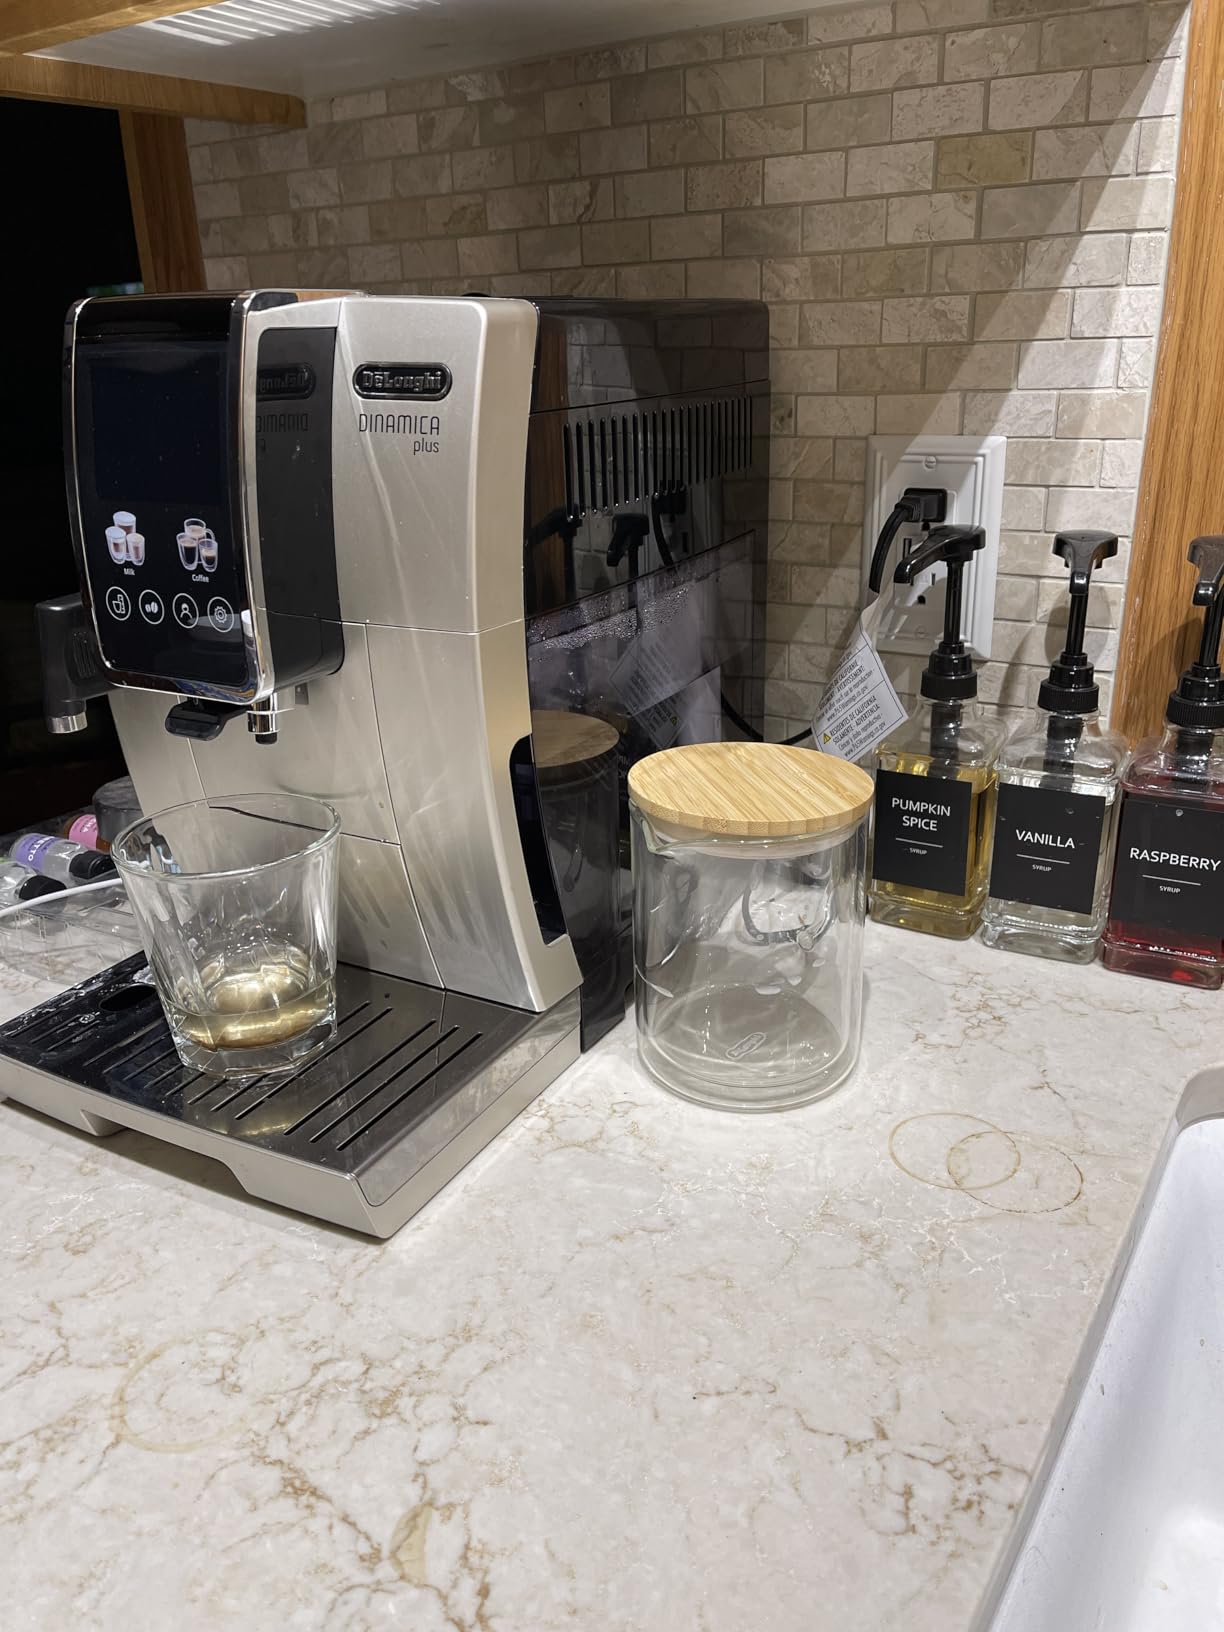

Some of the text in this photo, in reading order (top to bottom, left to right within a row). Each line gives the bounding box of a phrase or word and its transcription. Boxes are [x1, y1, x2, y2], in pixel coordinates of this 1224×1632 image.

[359, 413, 441, 436] DINAMICA
[413, 438, 440, 455] plus
[123, 567, 136, 576] Milk
[191, 574, 210, 583] Coffee
[891, 797, 951, 817] PUMPKIN
[902, 815, 938, 832] SPICE
[1015, 829, 1076, 849] VANILLA
[909, 847, 928, 855] SYRUP
[1130, 847, 1222, 872] RASPBERRY
[1032, 864, 1052, 872] SYRUP
[1159, 885, 1181, 894] SYRUP
